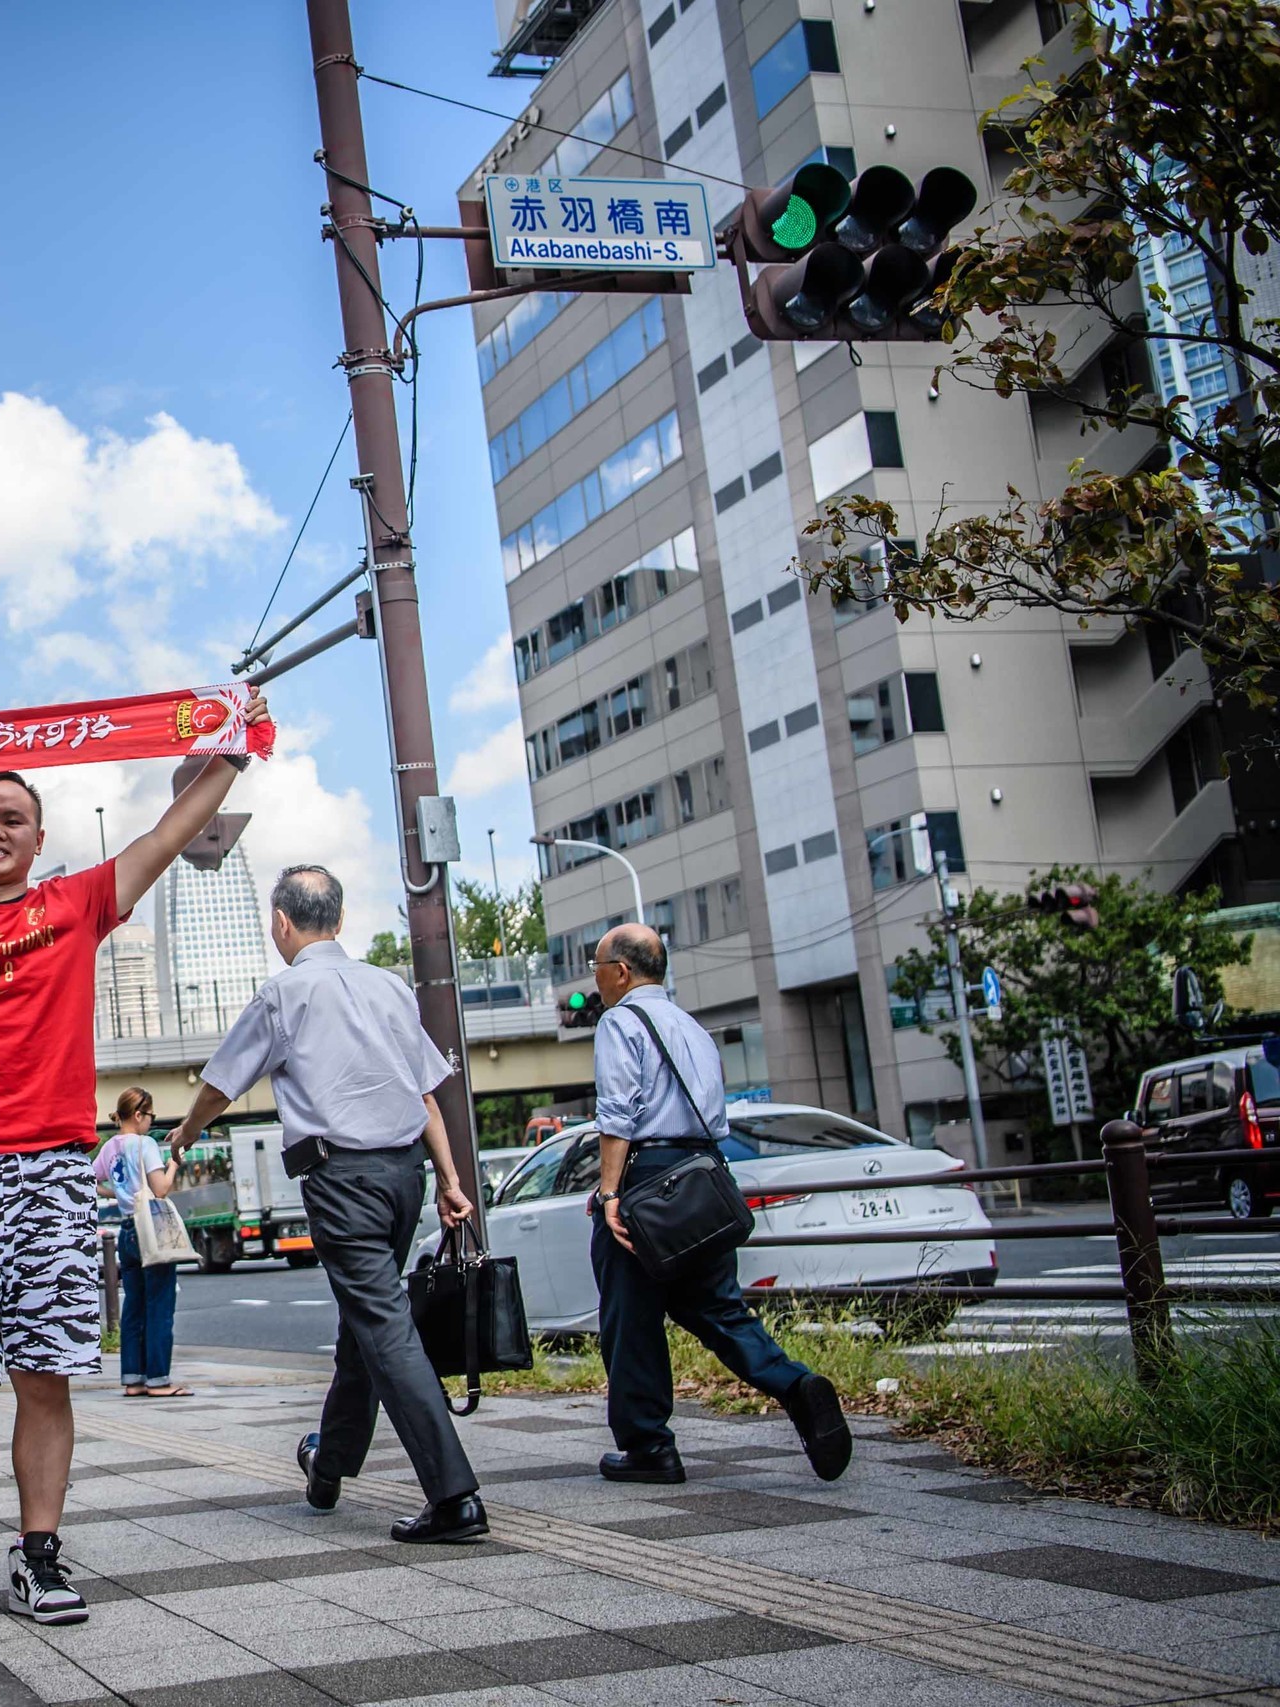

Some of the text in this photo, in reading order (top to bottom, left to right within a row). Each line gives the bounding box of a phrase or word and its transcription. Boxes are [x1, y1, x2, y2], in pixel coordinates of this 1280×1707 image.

[526, 178, 563, 193] 港区
[510, 195, 691, 236] 赤羽橋南
[510, 238, 684, 262] Akabanebashi-S.
